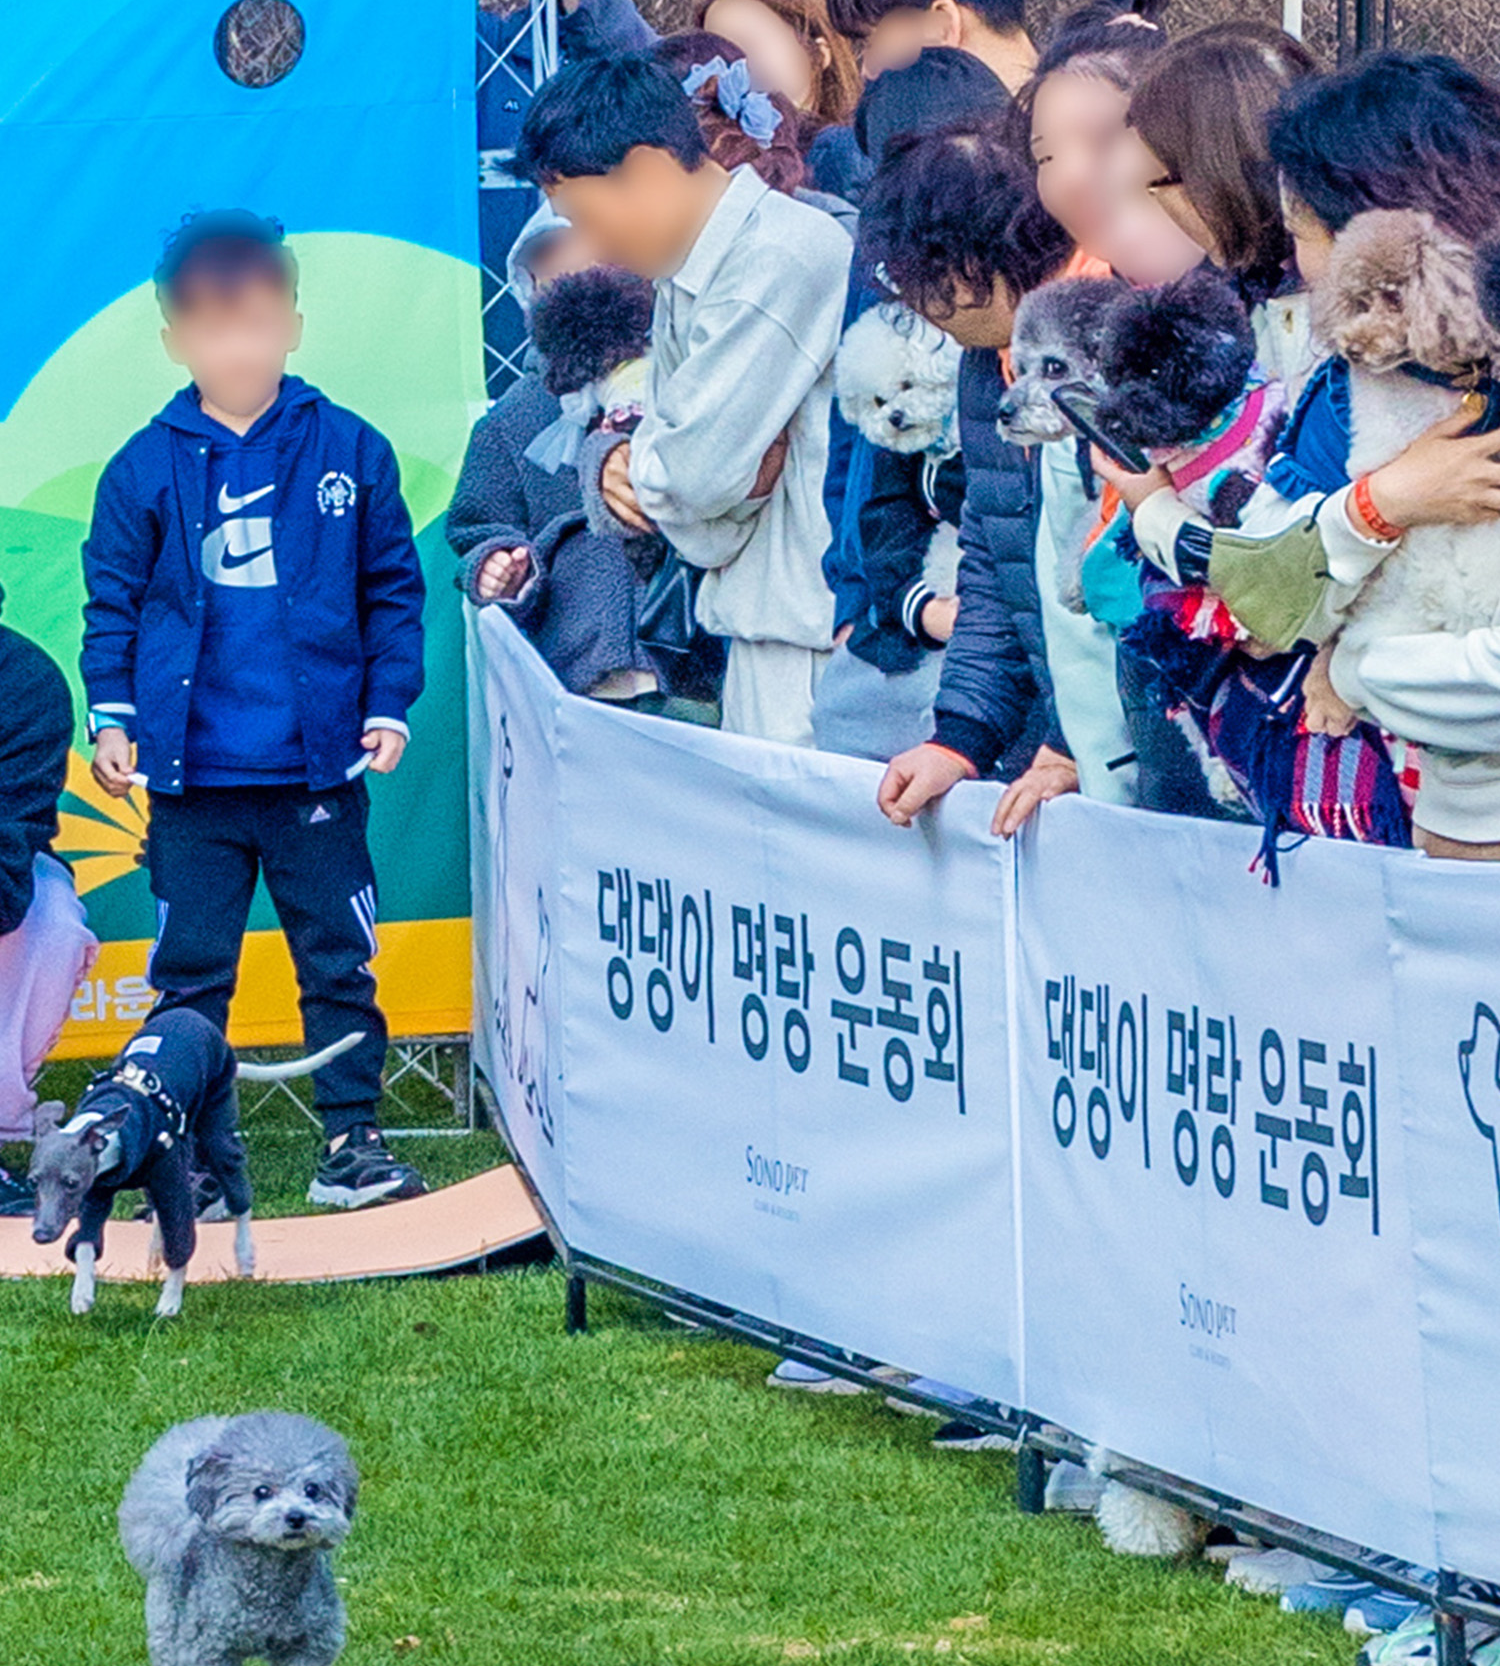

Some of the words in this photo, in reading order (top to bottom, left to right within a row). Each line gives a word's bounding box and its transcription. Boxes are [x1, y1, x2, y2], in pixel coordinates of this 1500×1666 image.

[598, 867, 715, 1044] 댕댕이
[731, 903, 815, 1074] 명랑
[831, 926, 966, 1115] 운동회
[1045, 975, 1151, 1169] 댕댕이
[1166, 1005, 1242, 1199] 명랑
[1255, 1028, 1380, 1236] 운동회
